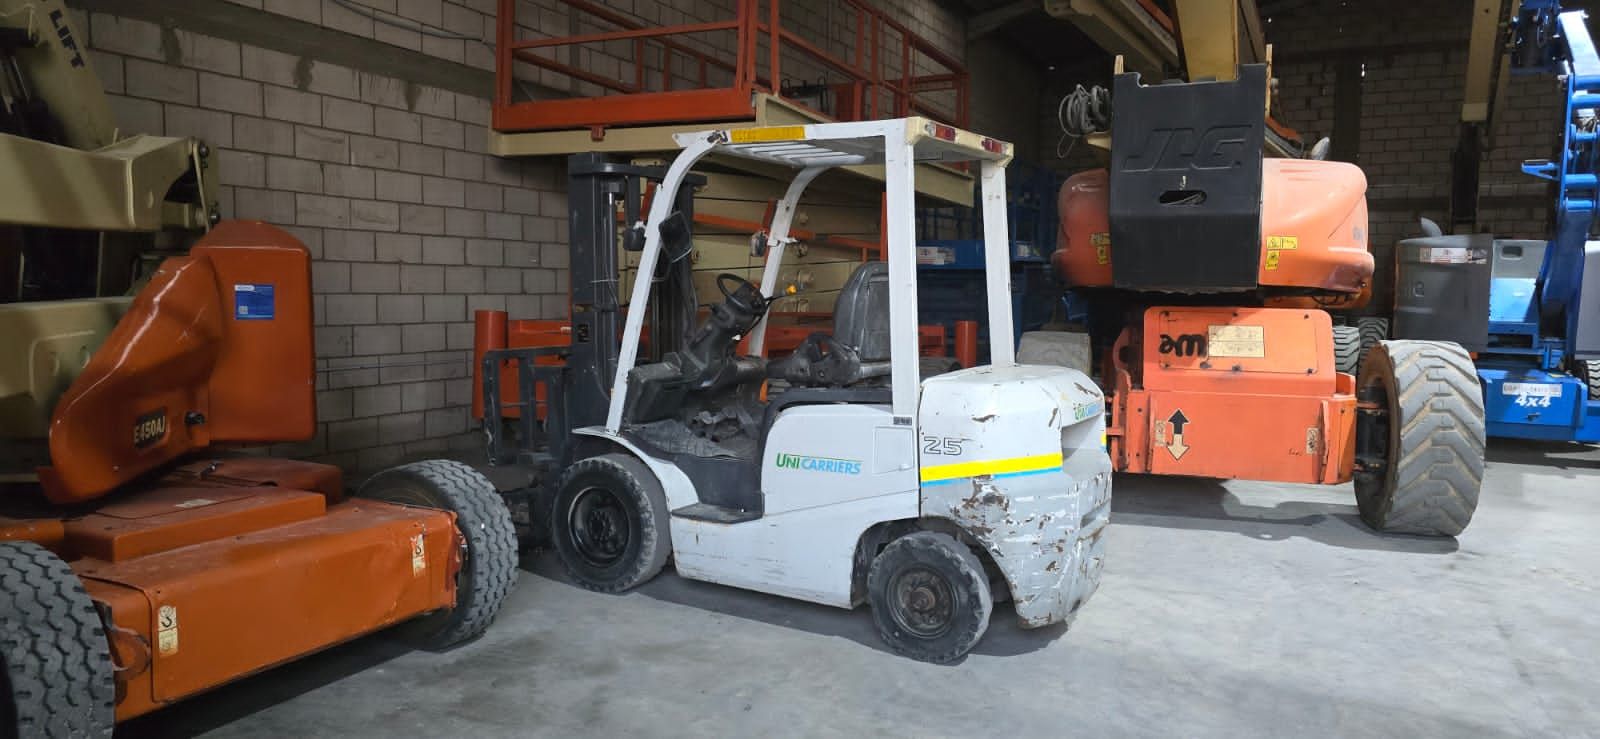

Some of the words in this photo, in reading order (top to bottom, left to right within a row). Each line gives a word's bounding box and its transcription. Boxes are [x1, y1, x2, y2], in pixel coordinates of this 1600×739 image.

[50, 9, 85, 68] LIFT
[1514, 390, 1551, 407] 4x4
[923, 436, 962, 455] 25
